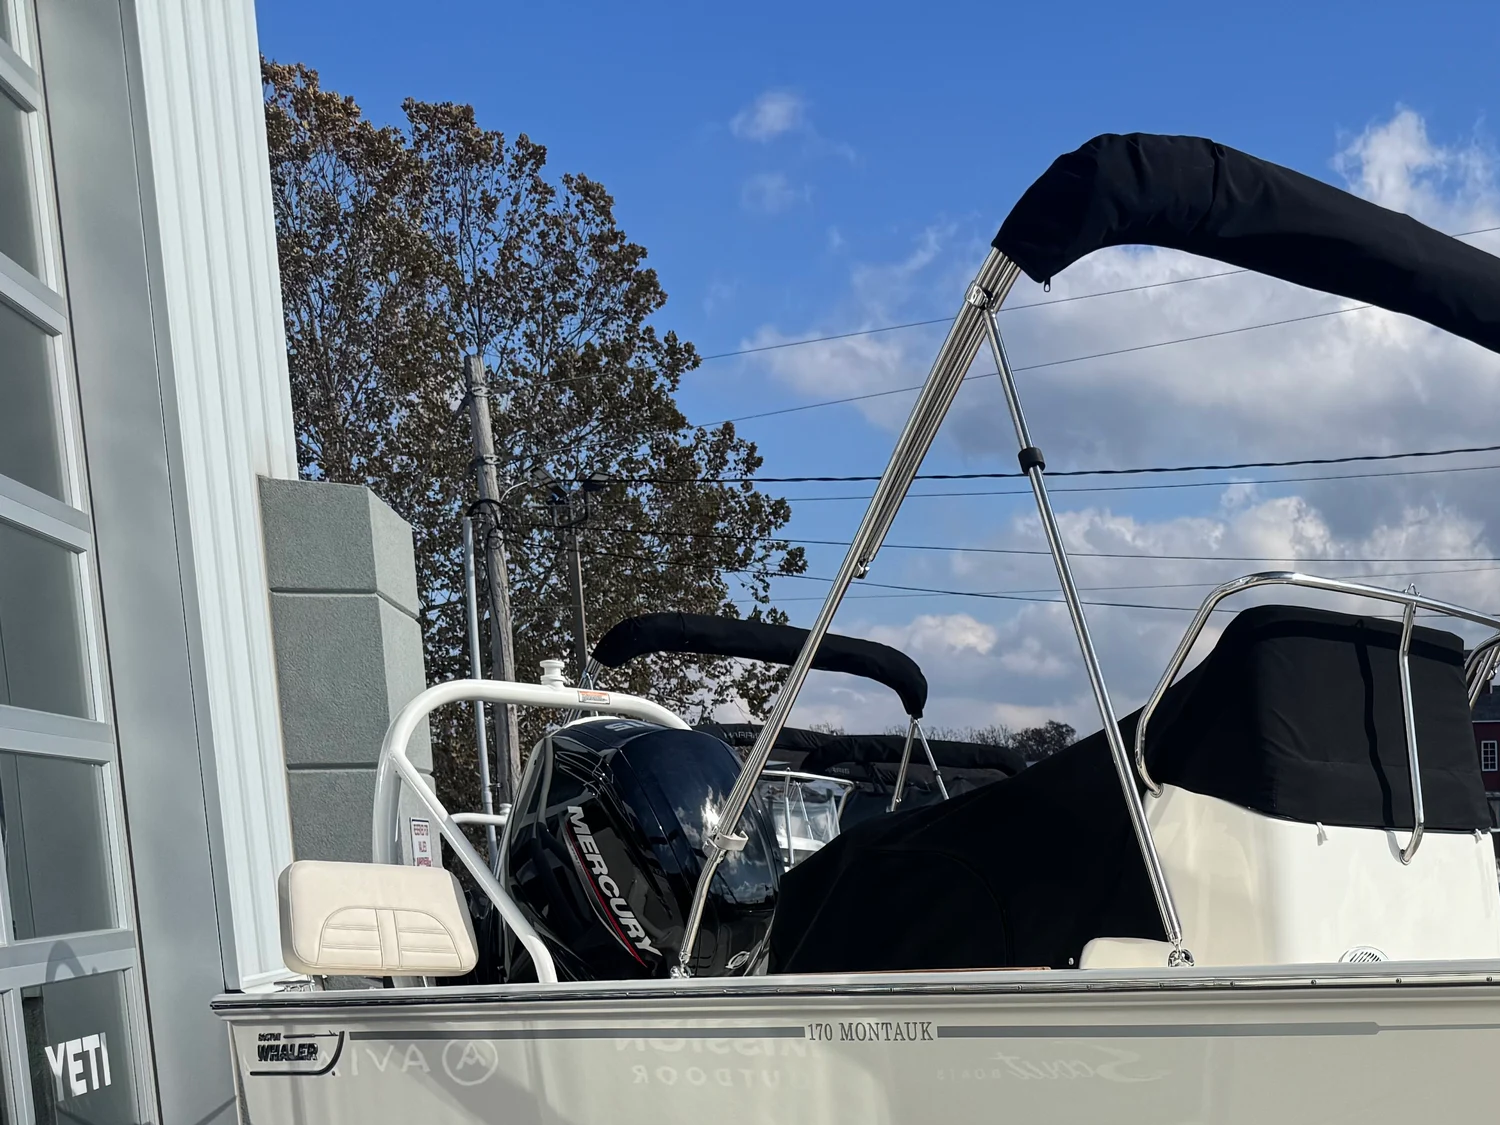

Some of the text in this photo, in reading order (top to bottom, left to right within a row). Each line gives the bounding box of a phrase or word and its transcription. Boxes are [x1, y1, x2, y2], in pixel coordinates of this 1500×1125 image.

[567, 805, 663, 957] MERCURY
[257, 1043, 319, 1062] WHALER
[807, 1021, 934, 1041] 170 MONTAUK
[44, 1032, 112, 1102] YETI
